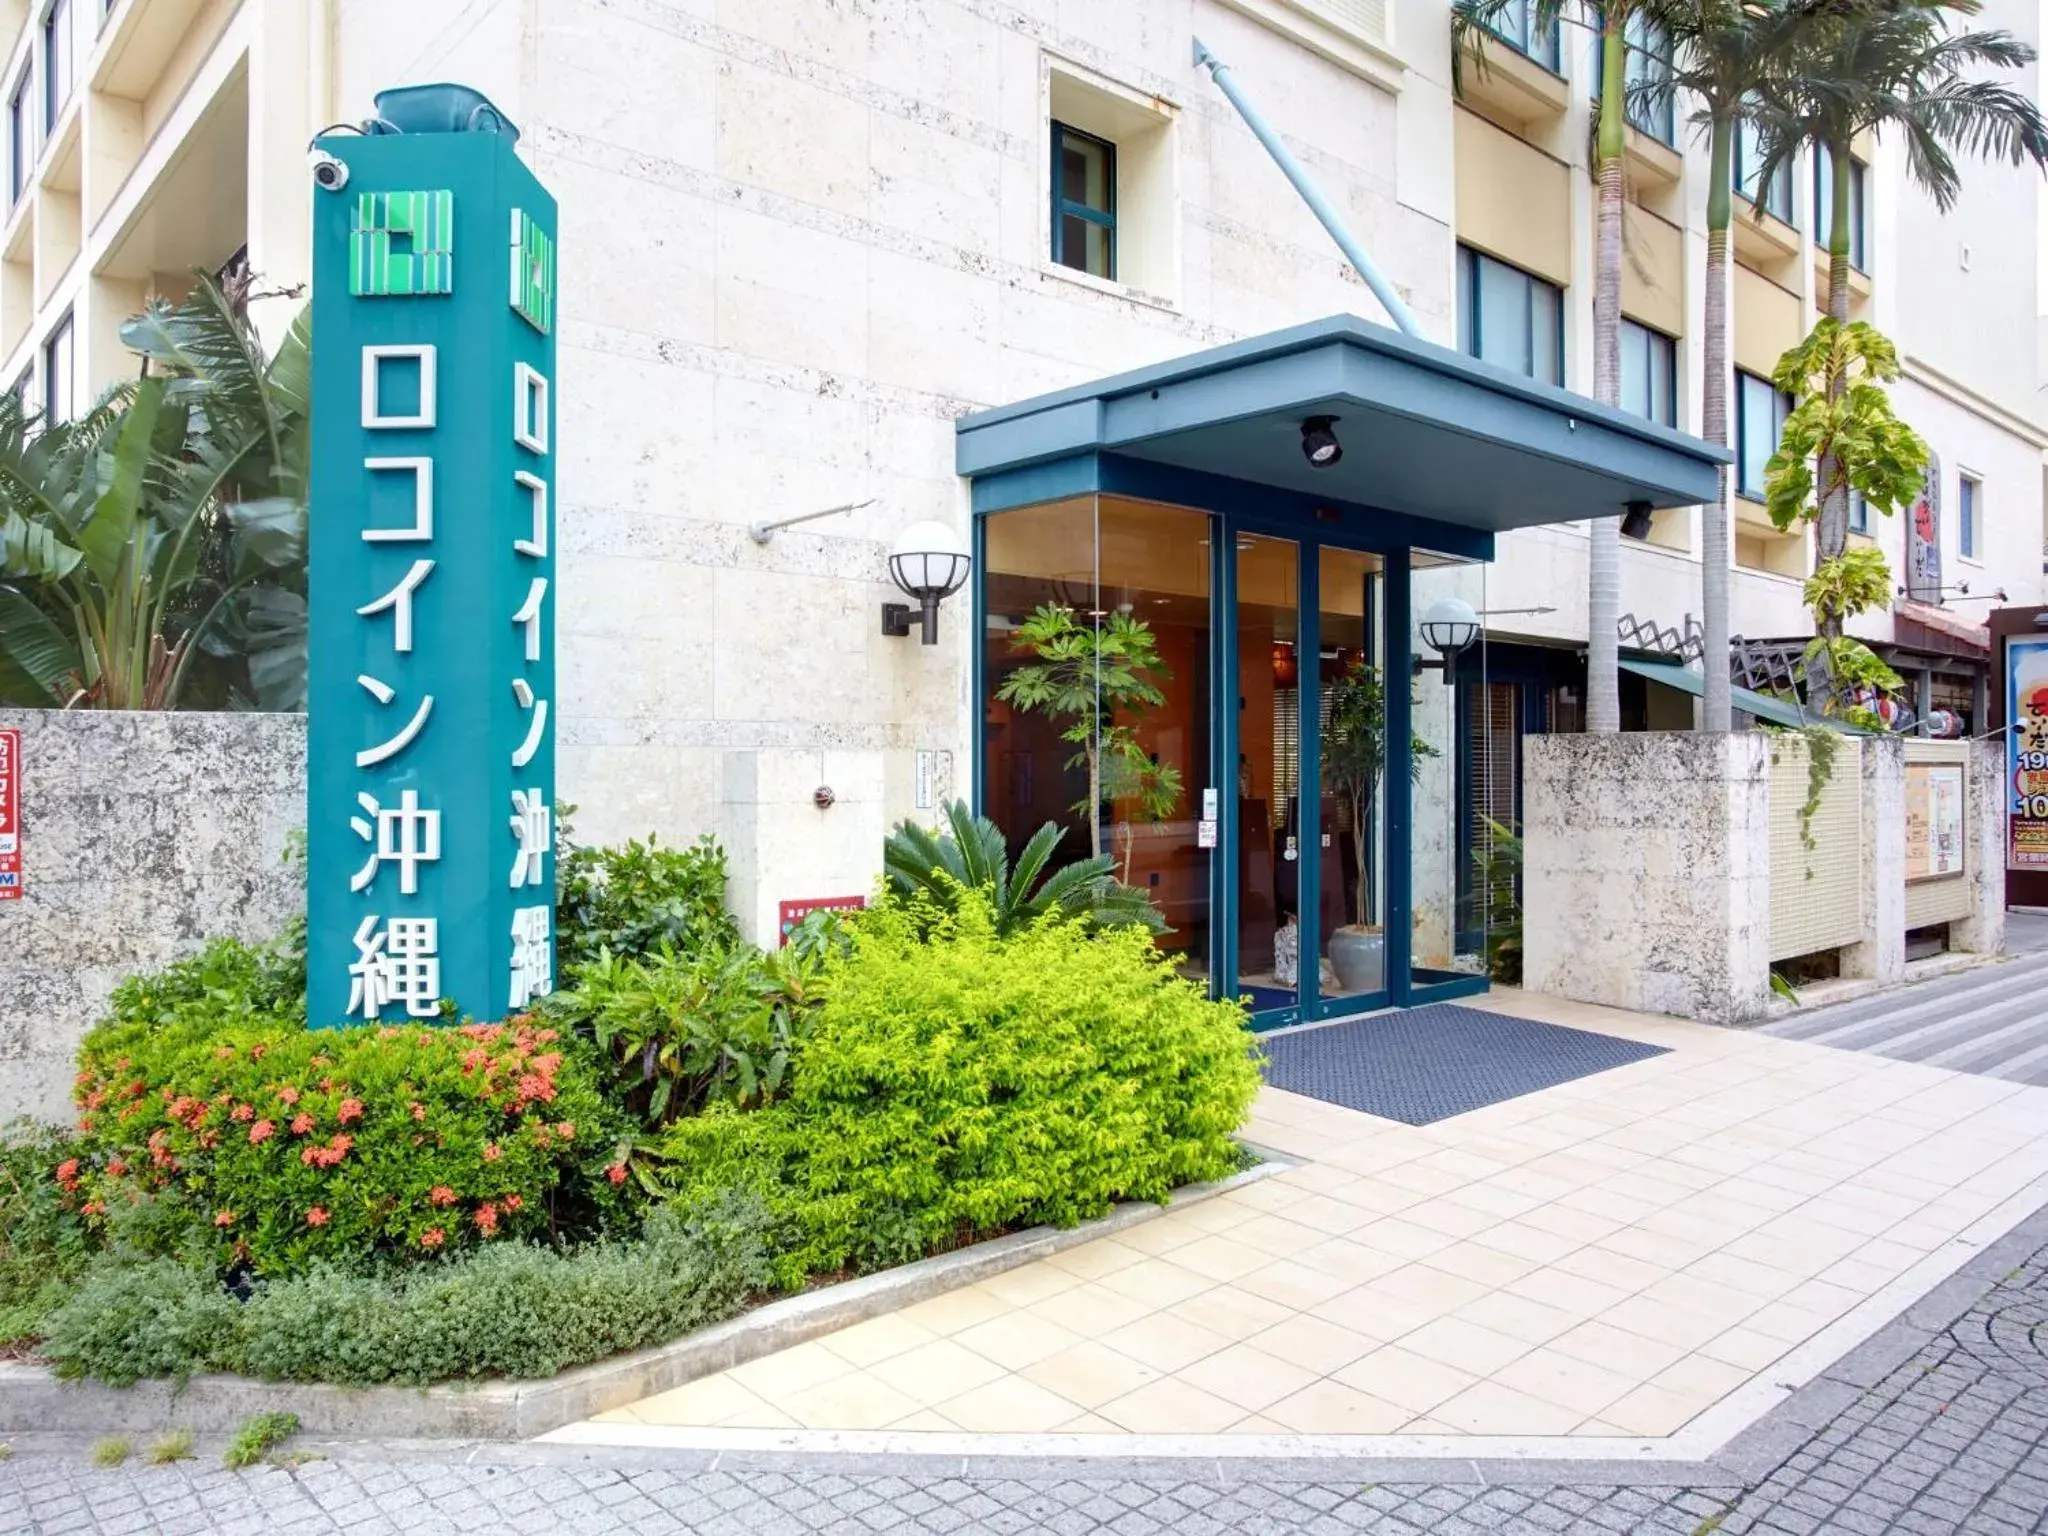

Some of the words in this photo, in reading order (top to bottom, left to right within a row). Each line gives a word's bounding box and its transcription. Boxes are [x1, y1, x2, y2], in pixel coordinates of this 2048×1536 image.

[346, 343, 441, 1020] ロコイン沖縄
[508, 360, 552, 1009] ロコイン沖縄
